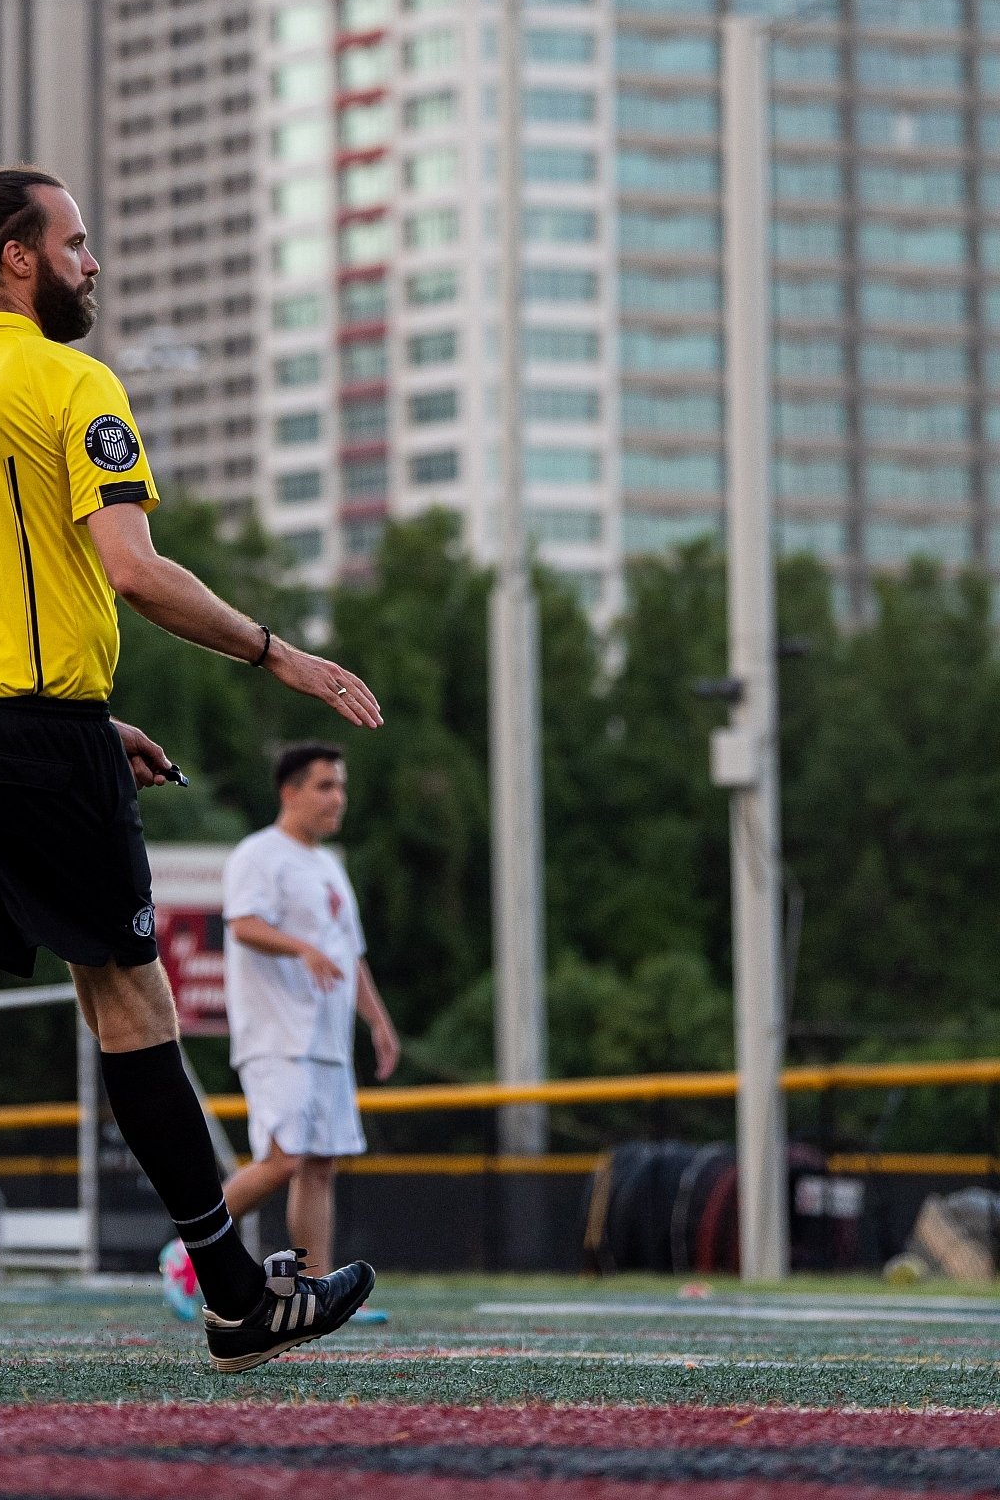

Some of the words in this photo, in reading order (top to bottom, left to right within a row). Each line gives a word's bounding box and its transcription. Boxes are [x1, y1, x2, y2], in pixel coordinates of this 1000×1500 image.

[88, 416, 108, 434] SOCCER
[108, 416, 137, 443] FEDERATION
[101, 429, 123, 443] USA
[93, 456, 118, 471] REFEREE
